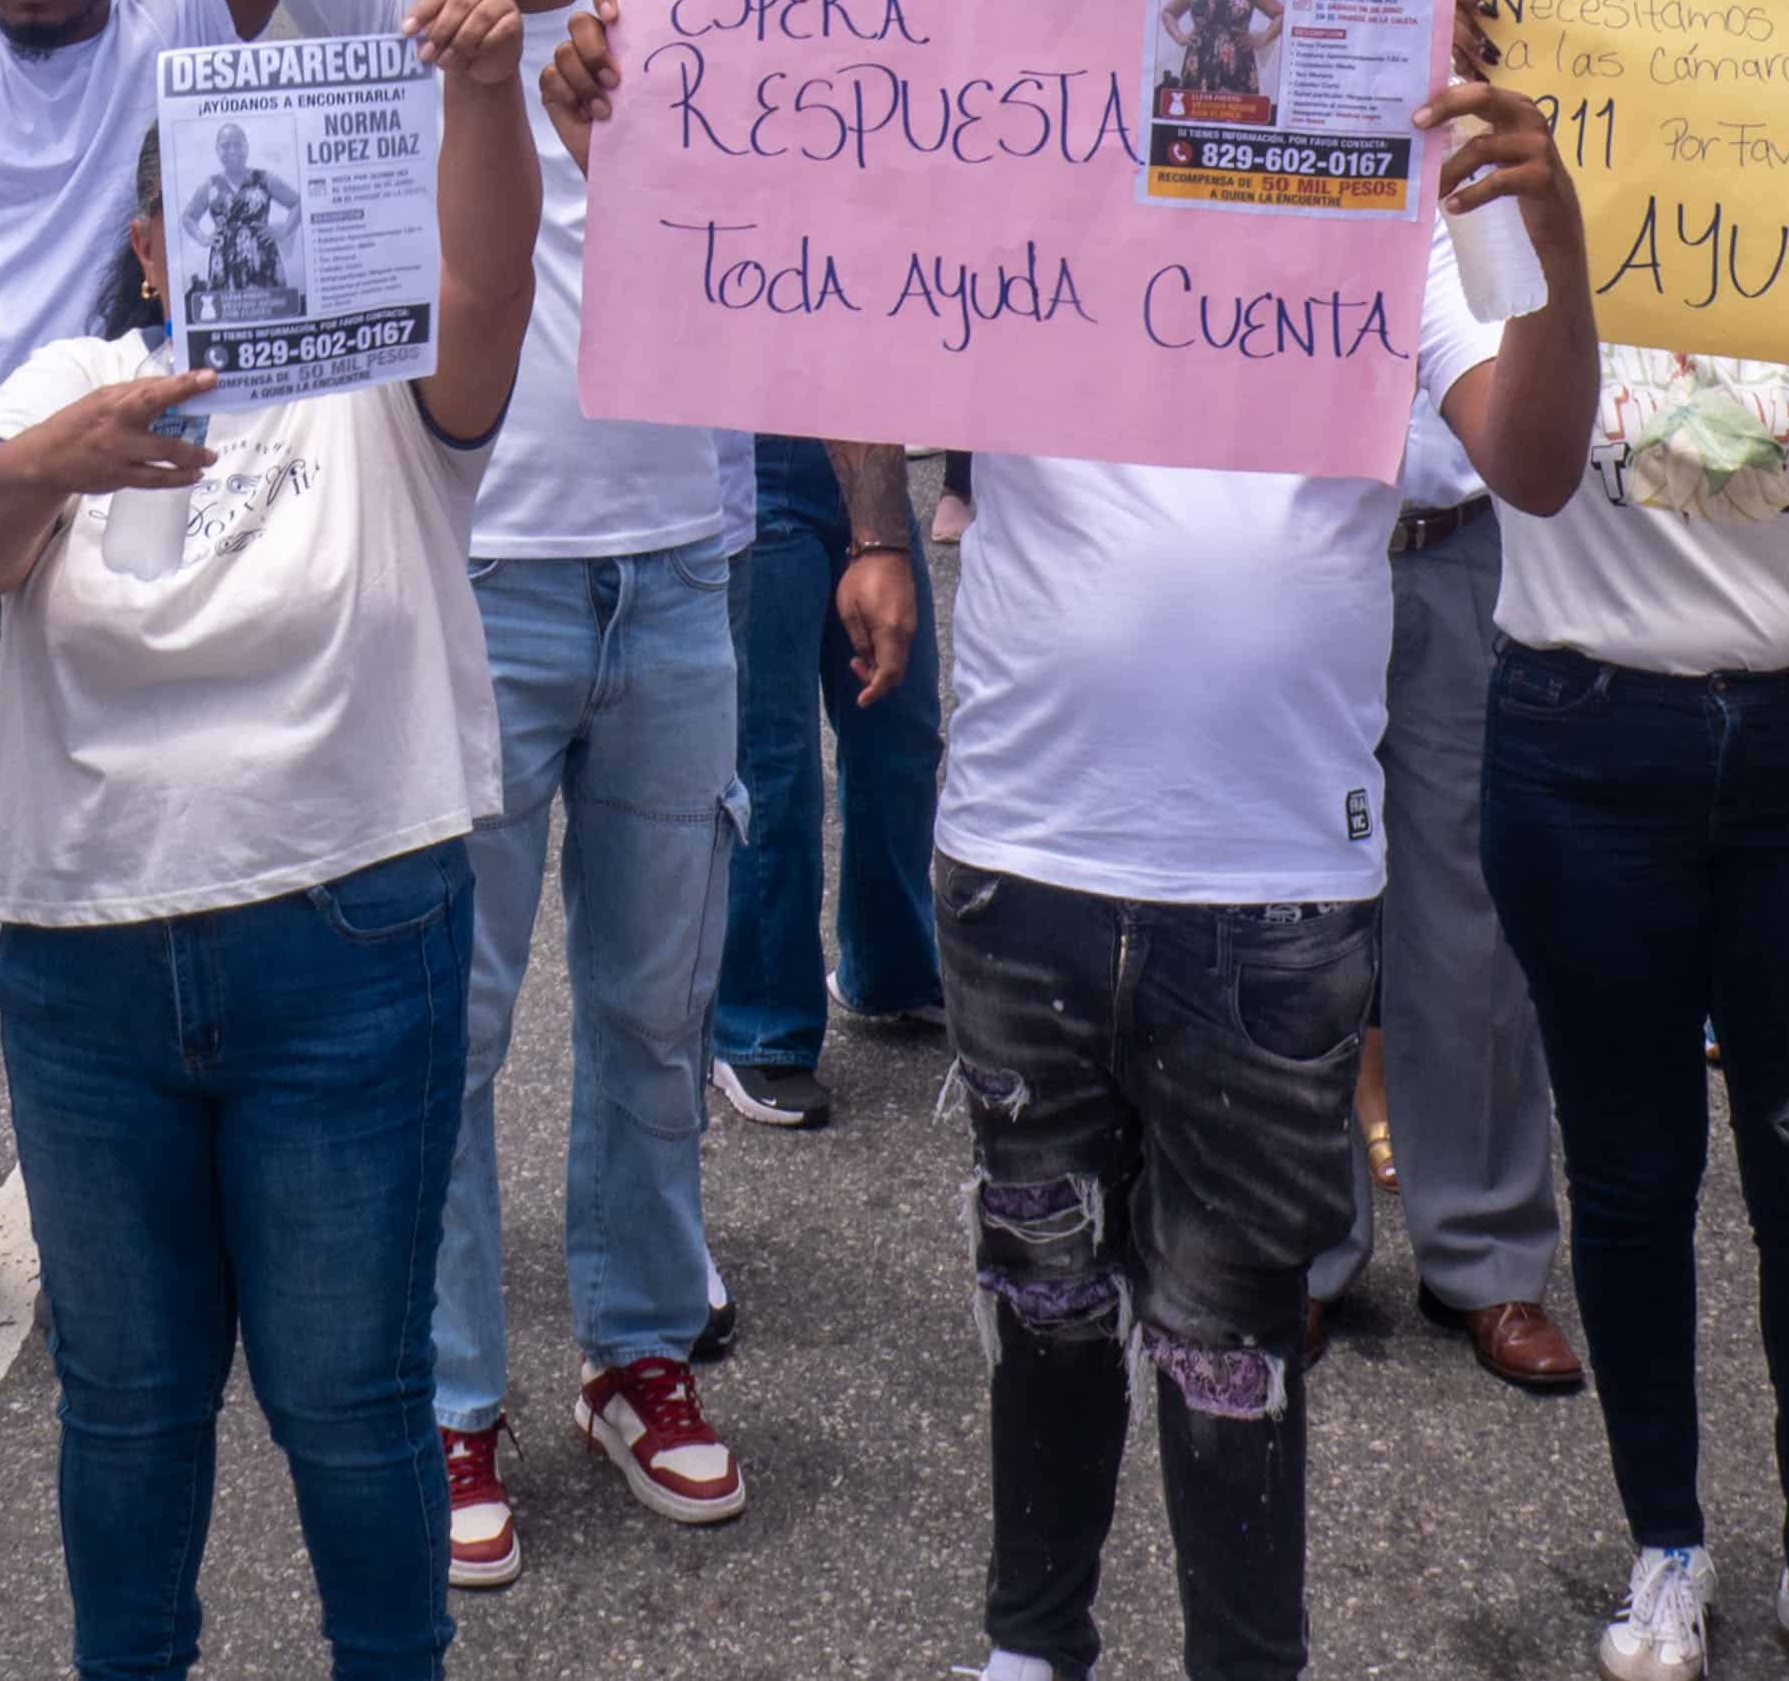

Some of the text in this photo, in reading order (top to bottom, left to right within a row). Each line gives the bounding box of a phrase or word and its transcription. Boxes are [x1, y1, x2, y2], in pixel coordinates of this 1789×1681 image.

[171, 39, 425, 93] DESAPARECIDA
[1556, 30, 1624, 78] las
[198, 87, 406, 116] ¡AYÚDANOS A ENCONTRARLA!
[643, 42, 1146, 169] RESPUESTA
[324, 109, 402, 136] NORMA
[1189, 129, 1220, 140] TIENES
[1288, 135, 1307, 145] POR
[1309, 136, 1339, 147] FAVOR
[1660, 118, 1721, 161] Por
[307, 133, 420, 165] LOPEZ DIAZ
[1201, 142, 1393, 176] 829-602-0167
[1157, 171, 1397, 197] RECOMPENSA DE 50 MIL PESOS
[1210, 189, 1342, 207] A QUIEN LA ENCUENTRE
[1143, 264, 1410, 360] CUENTA
[238, 320, 416, 368] 829-602-0167
